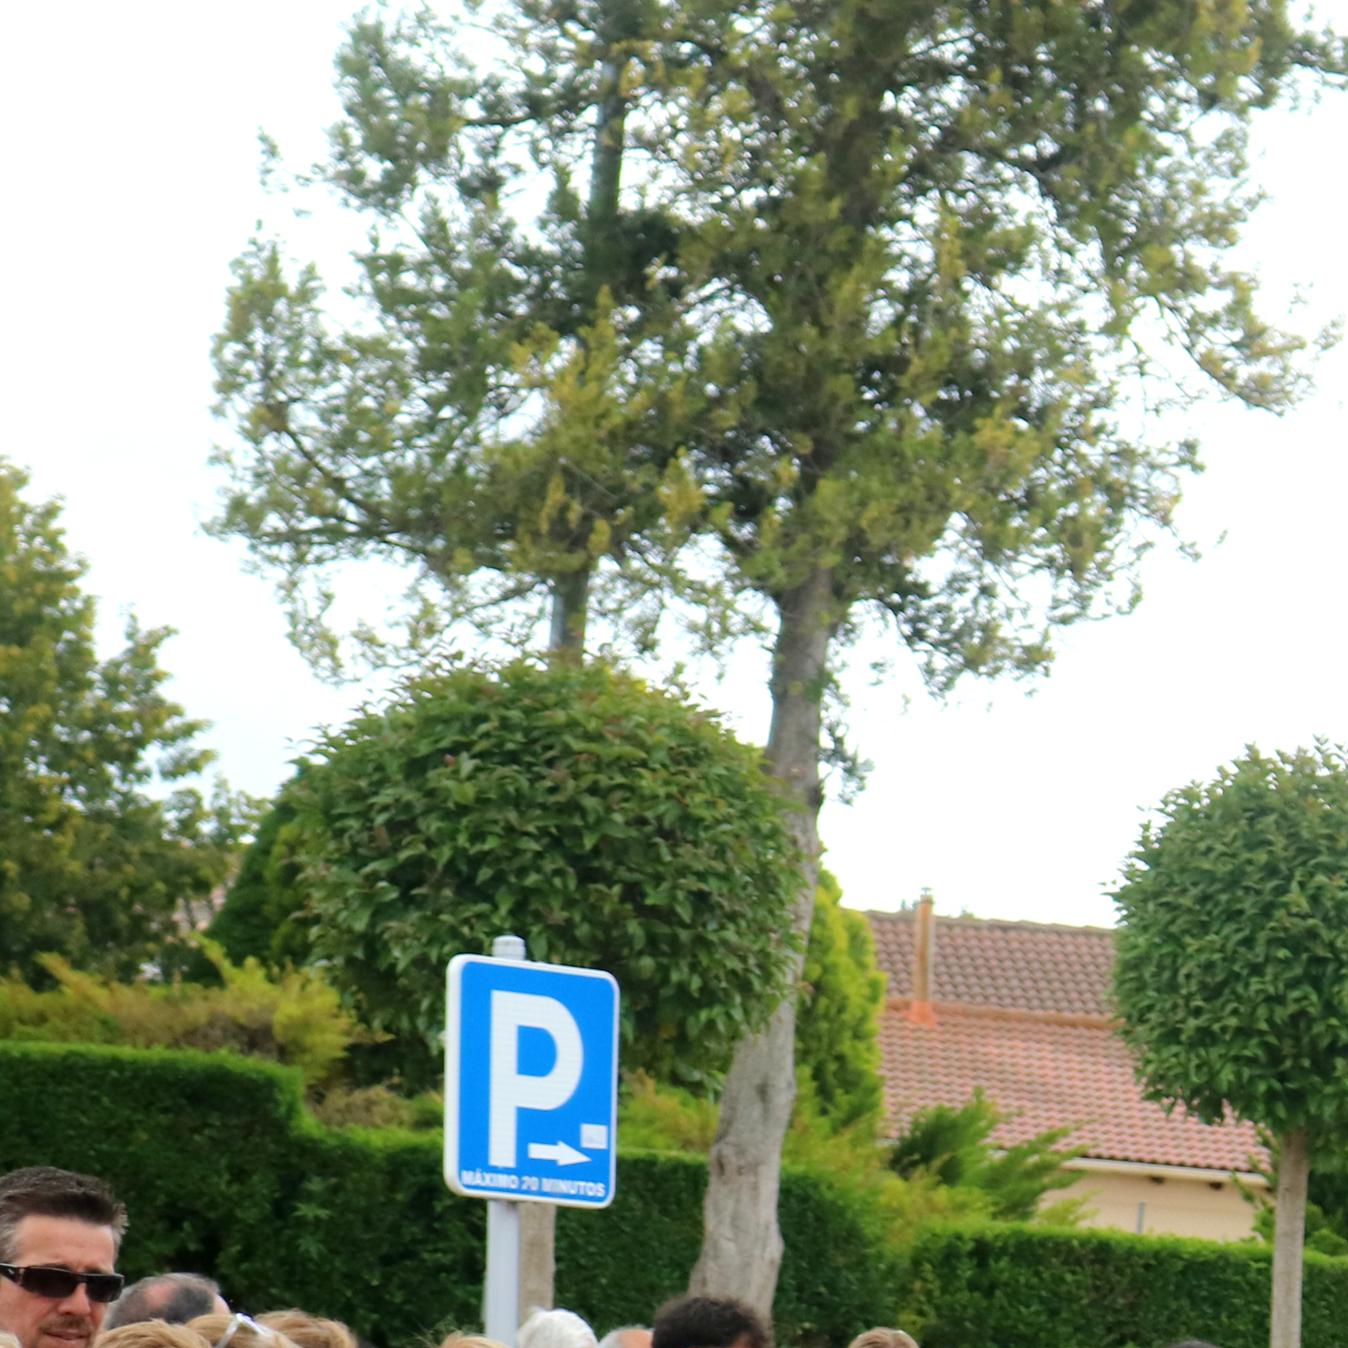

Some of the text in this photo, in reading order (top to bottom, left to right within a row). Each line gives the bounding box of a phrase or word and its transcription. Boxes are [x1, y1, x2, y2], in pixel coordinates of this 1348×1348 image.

[489, 991, 583, 1168] P
[461, 1168, 606, 1197] MÁXIMO 20 MINUTOS
